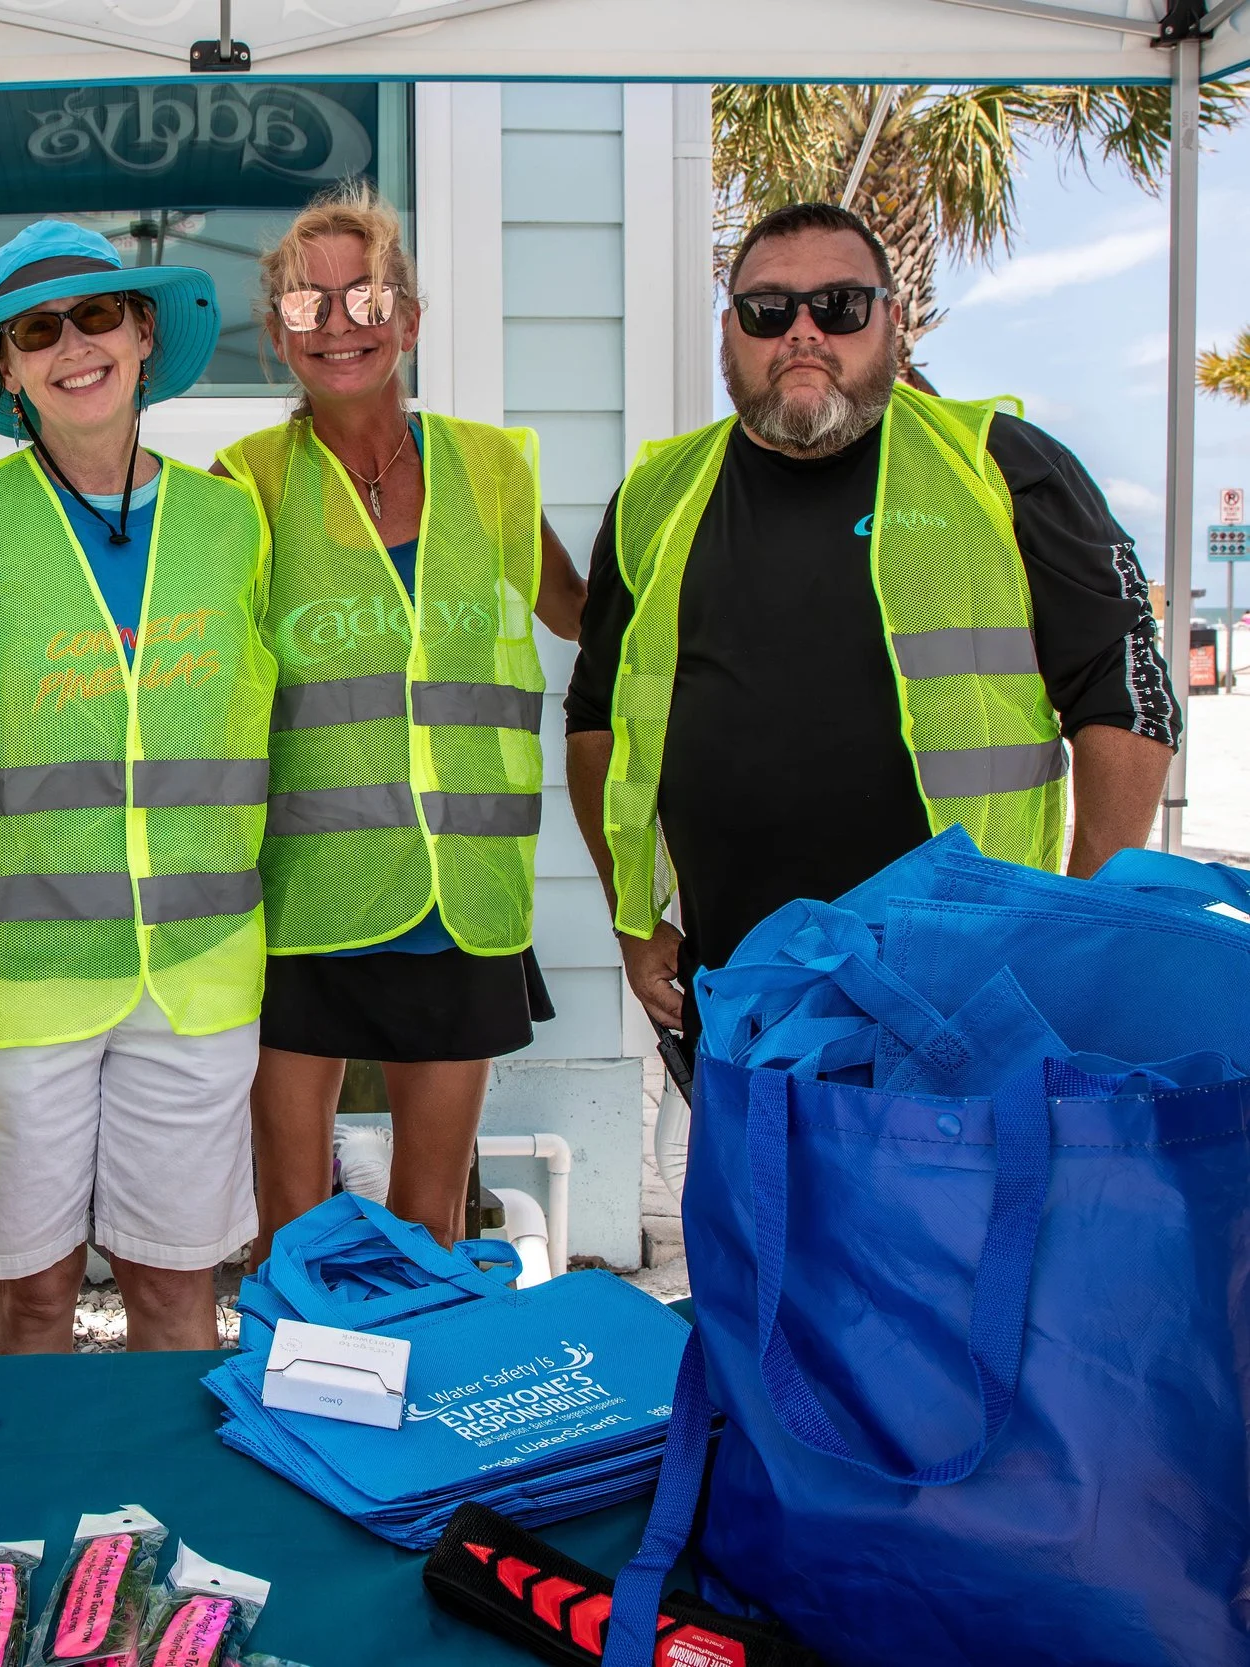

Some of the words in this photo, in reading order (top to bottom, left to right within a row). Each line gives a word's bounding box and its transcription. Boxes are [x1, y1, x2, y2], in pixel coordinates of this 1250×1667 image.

[46, 608, 228, 660] CONNECT
[33, 650, 220, 714] PINELAS
[319, 1396, 337, 1405] MOO
[427, 1381, 484, 1405] Water
[483, 1363, 539, 1387] Safety
[535, 1356, 555, 1369] Is
[437, 1371, 593, 1428] EVERYONE'S
[454, 1384, 611, 1441] RESPONSIBILITY
[515, 1414, 632, 1453] WaterSmartFL
[93, 1580, 109, 1599] Alive
[81, 1599, 104, 1644] Tomorrow
[188, 1635, 207, 1657] Alive
[666, 1644, 711, 1667] TOMORROW
